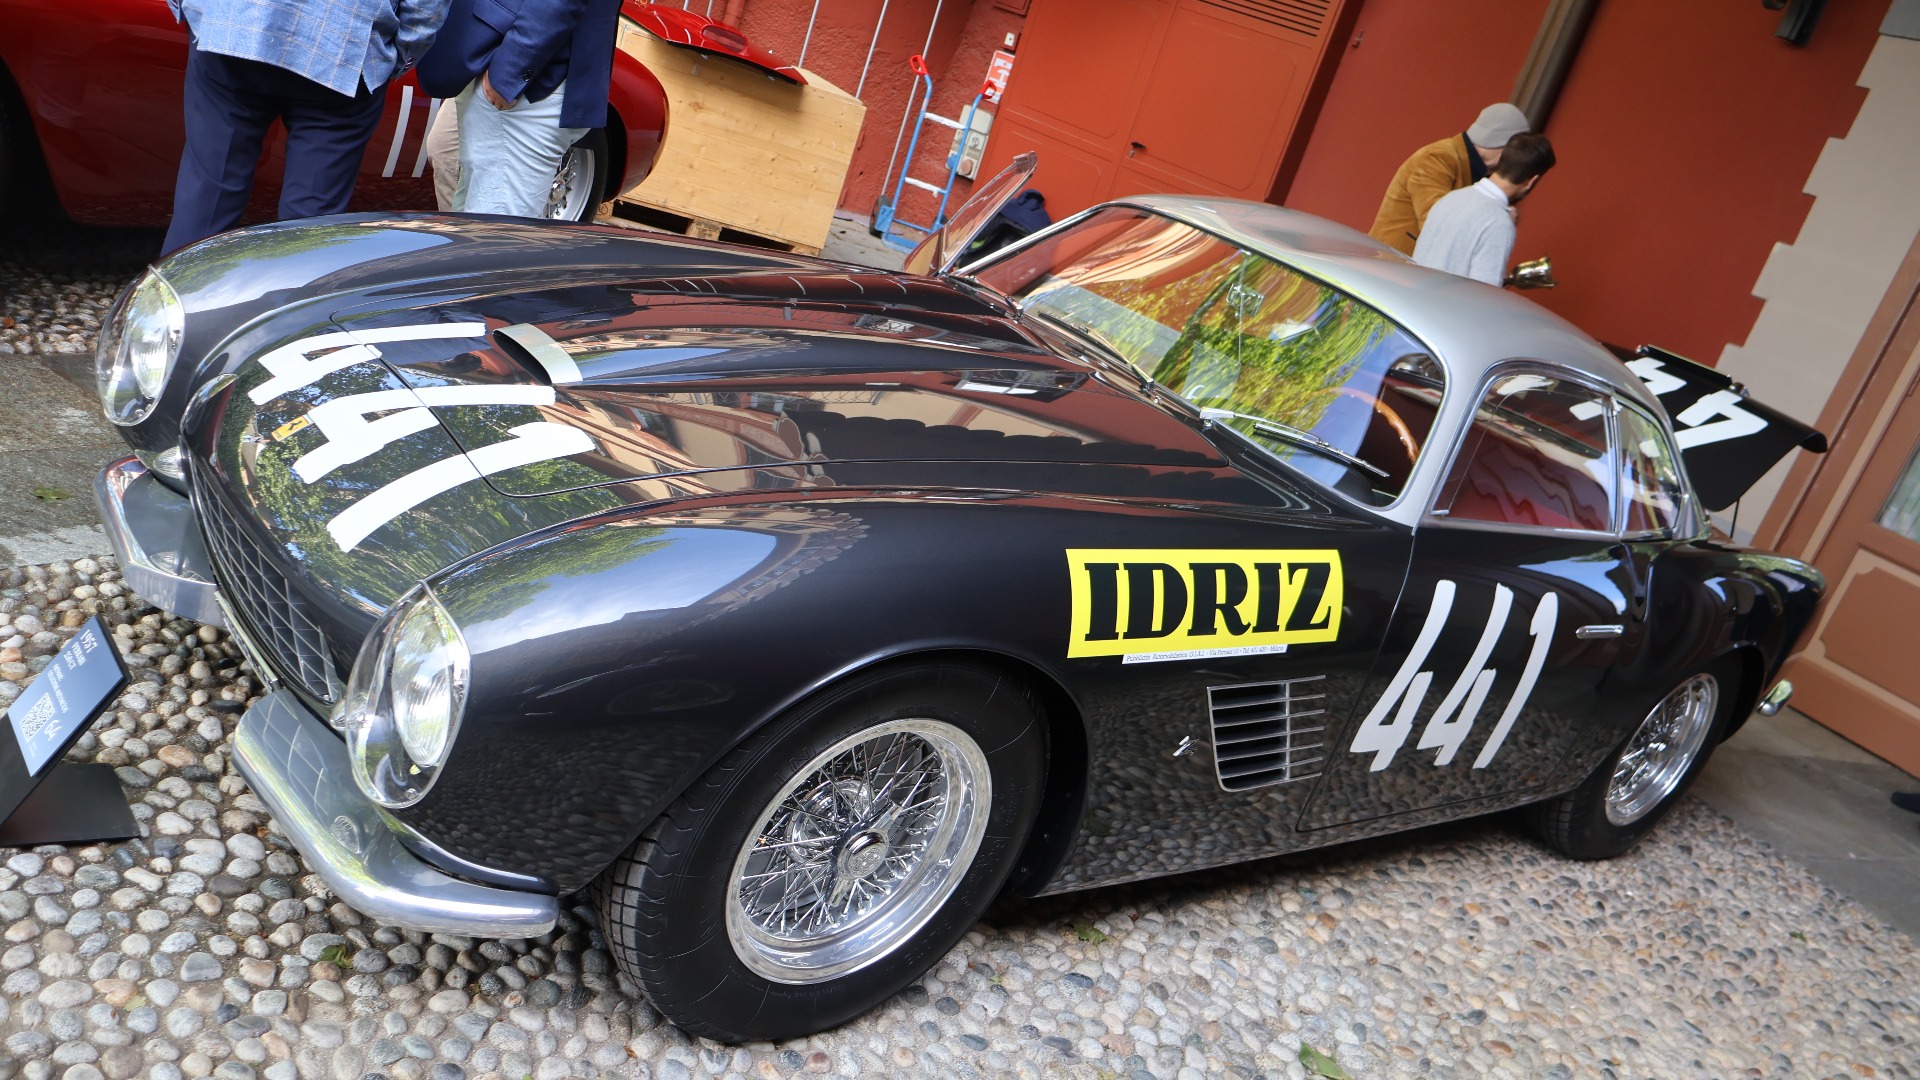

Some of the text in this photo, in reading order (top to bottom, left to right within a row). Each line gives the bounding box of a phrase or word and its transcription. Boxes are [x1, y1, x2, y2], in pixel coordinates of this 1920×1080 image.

[247, 322, 596, 554] 441
[1083, 562, 1332, 642] IDRIZ
[71, 641, 86, 666] FERRARI
[80, 629, 98, 654] 1957
[1349, 579, 1559, 772] 441
[44, 719, 63, 741] 64
